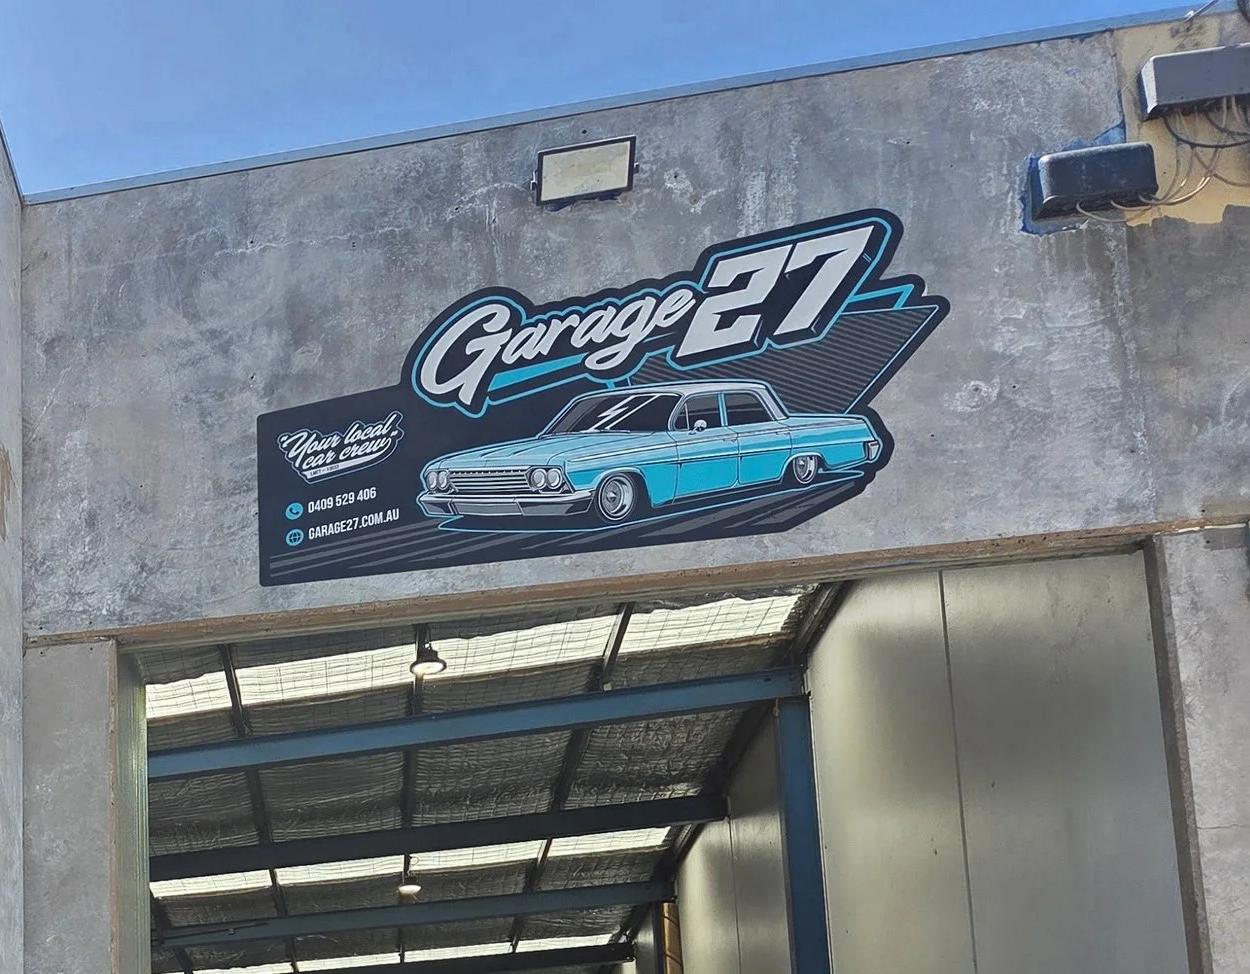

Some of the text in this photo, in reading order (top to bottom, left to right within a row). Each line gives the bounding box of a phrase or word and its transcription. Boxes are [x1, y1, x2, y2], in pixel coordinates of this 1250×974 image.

[420, 225, 875, 406] Garage 27
[343, 413, 398, 445] local
[302, 450, 337, 470] car
[308, 487, 377, 513] 0409 529 406
[308, 508, 400, 540] GARAGE27.COM.AU
